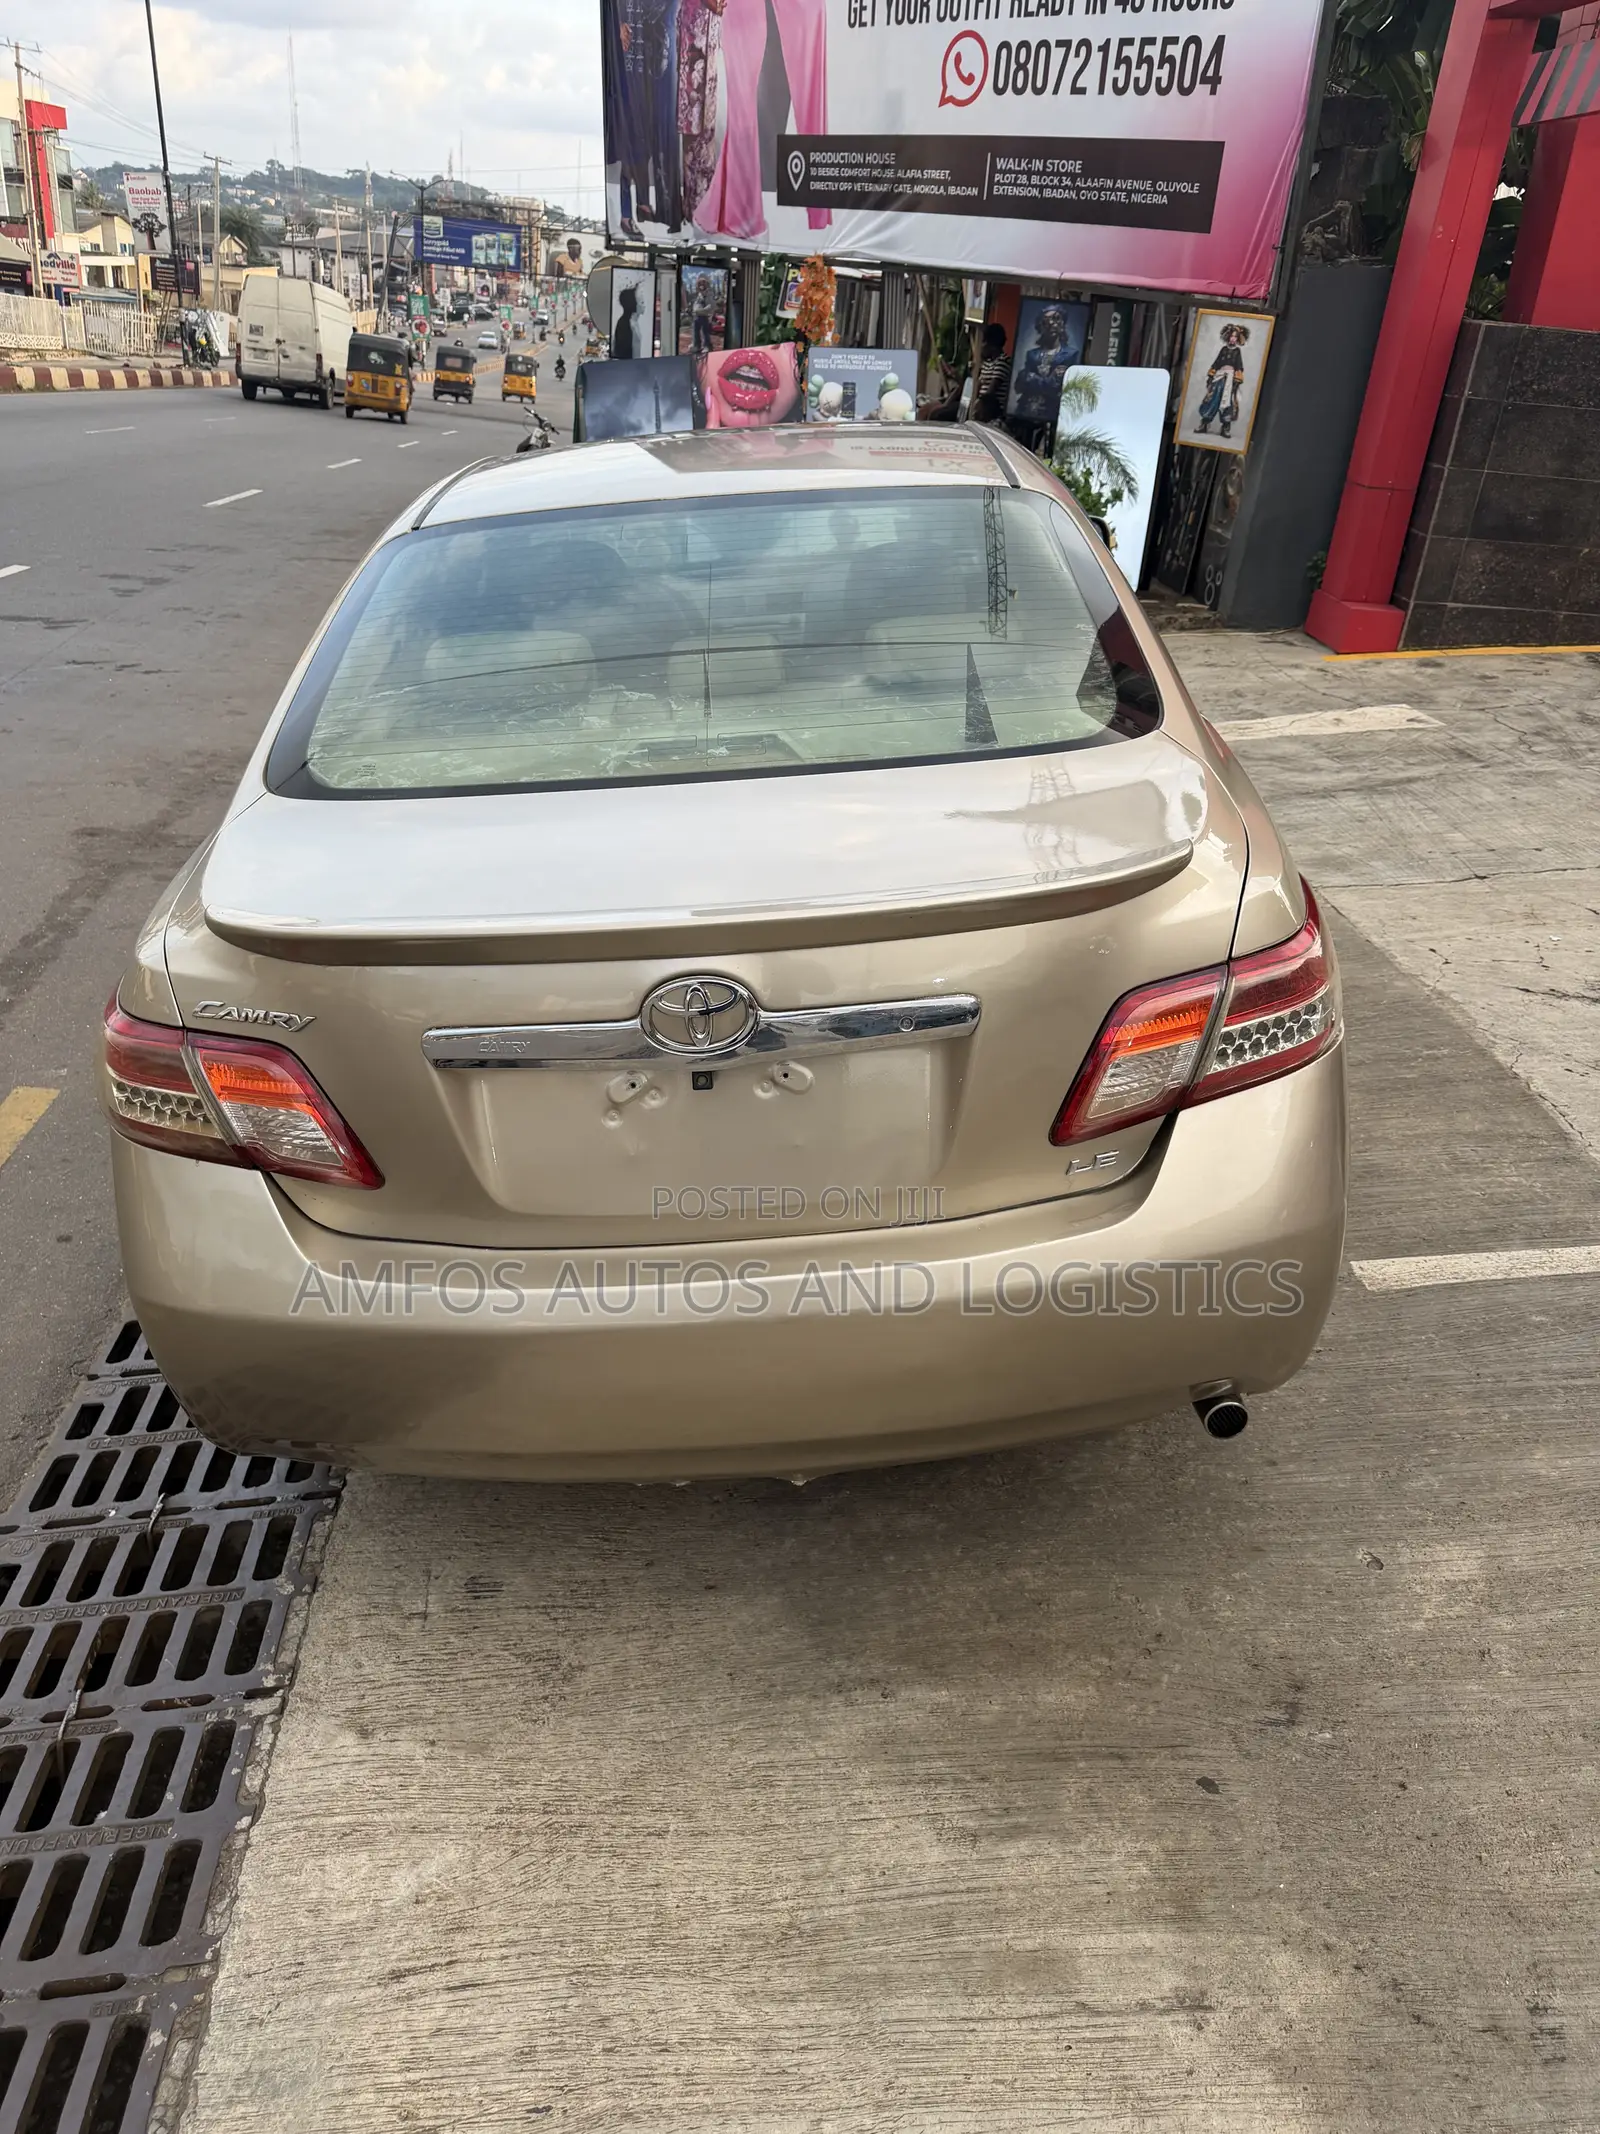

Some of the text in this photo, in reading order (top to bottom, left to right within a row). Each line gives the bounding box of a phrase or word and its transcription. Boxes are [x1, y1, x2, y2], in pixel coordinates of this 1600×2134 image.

[992, 34, 1227, 97] 08072155504
[810, 152, 896, 165] PRODUCTION HOUSE
[996, 158, 1083, 173] WALK-IN STORE
[818, 168, 840, 177] BESIDE
[840, 168, 871, 177] COMFORT
[897, 170, 922, 179] ALAFIA
[923, 170, 951, 180] STREET,
[129, 187, 162, 195] Baobab
[810, 182, 838, 191] DIRECTLY
[839, 182, 852, 191] OPP
[853, 183, 892, 192] VETERINARY
[913, 185, 946, 195] MOKOLA,
[948, 186, 978, 196] IBADAN
[994, 174, 1200, 194] PLOT 28, BLOCK 34, ALAAFIN AVENUE, OLUYOLE
[993, 187, 1168, 205] EXTENSION, IBADAN, OYO STATE, NIGERIA
[192, 1000, 316, 1032] CAMRY
[1065, 1150, 1120, 1176] LE
[156, 1591, 245, 1609] NIGERIAN
[44, 1599, 150, 1621] FOUNDRIES
